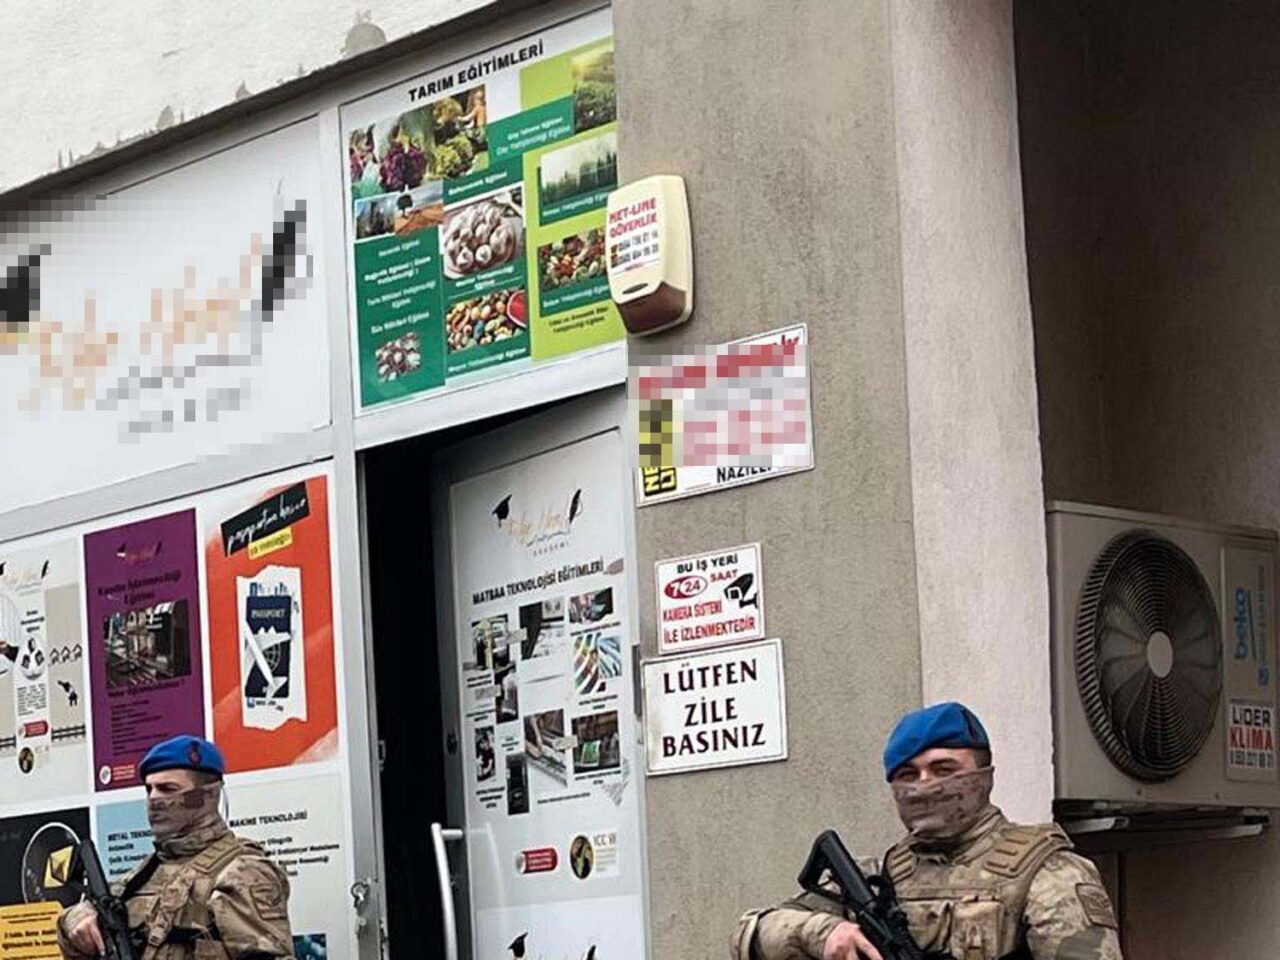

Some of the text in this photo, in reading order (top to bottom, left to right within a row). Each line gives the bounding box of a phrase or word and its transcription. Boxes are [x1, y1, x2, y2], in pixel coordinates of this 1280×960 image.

[408, 38, 544, 102] TARIM EĞİTİMLERİ
[677, 562, 693, 574] BU
[711, 553, 738, 569] YERİ
[710, 569, 737, 583] SAAT
[664, 616, 756, 643] İLE İZLENMEKTEDİR
[663, 658, 758, 694] LÜTFEN
[684, 697, 738, 728] ZİLE
[662, 723, 766, 758] BASINIZ
